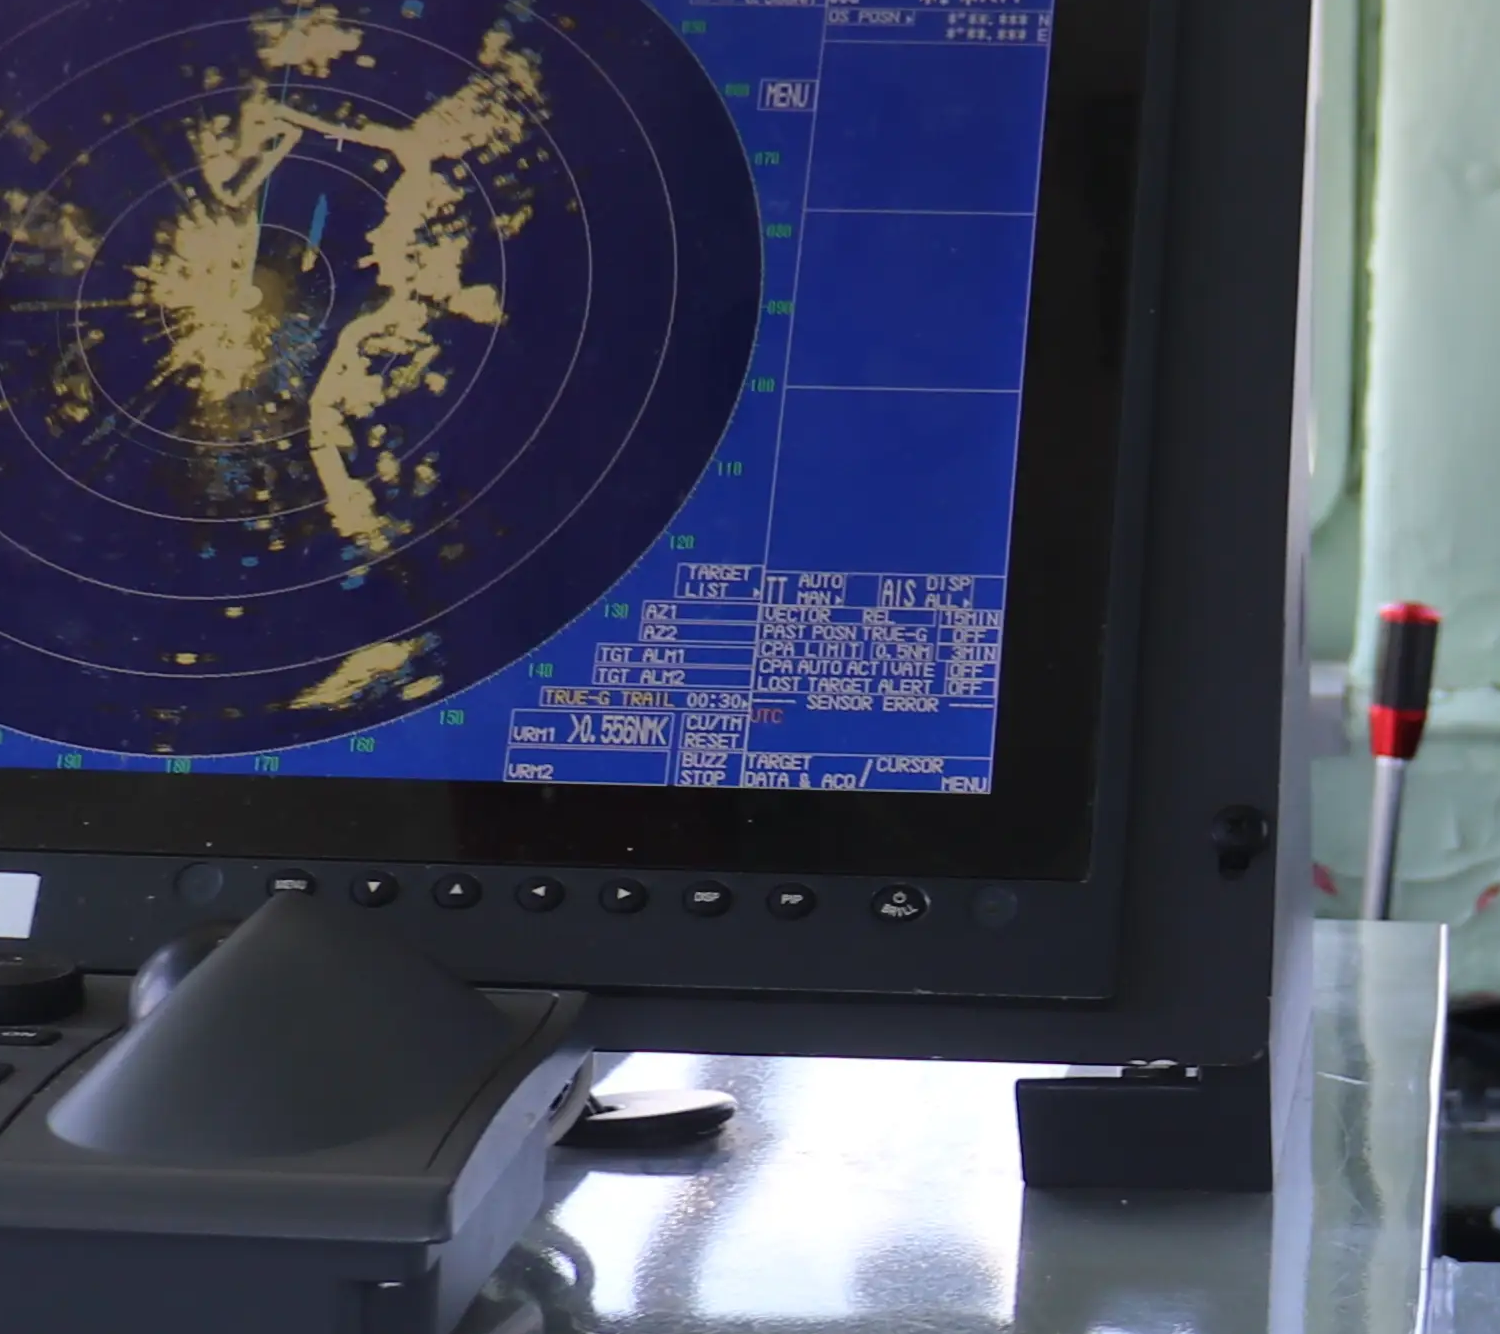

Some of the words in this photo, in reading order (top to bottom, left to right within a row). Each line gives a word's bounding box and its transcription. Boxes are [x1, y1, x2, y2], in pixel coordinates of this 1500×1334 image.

[858, 10, 900, 23] POSN
[765, 83, 811, 108] MENU
[690, 565, 751, 581] TARGET
[685, 582, 729, 597] LIST
[766, 576, 788, 604] TT
[798, 575, 844, 589] AUTO
[926, 576, 972, 592] DISP
[797, 592, 831, 605] MAN
[881, 580, 917, 607] AIS
[924, 594, 958, 608] ALL
[646, 605, 677, 619] AZ1
[765, 607, 831, 622] VECTOR
[863, 610, 895, 624] REL
[942, 610, 999, 626] 15MIN
[643, 625, 677, 640] AZ2
[762, 625, 805, 639] PAST
[812, 626, 856, 641] POSN
[863, 627, 928, 642] TRUE-G
[952, 630, 986, 643] OFF
[602, 648, 633, 663] TGT
[643, 649, 686, 664] ALM1
[760, 642, 795, 657] CPA
[804, 643, 860, 658] LIMIT
[875, 644, 930, 660] 0.5NM
[951, 646, 996, 661] 3MIN
[758, 659, 793, 674] CPA
[797, 660, 842, 674] AUTO
[846, 661, 936, 678] ACTIVATE
[949, 663, 985, 678] OFF
[599, 668, 630, 683] TGT
[640, 670, 686, 686] ALM2
[757, 676, 802, 691] LOST
[808, 677, 871, 693] TARGET
[878, 679, 933, 695] ALERT
[948, 681, 982, 695] OFF
[545, 689, 611, 706] TRUE-G
[621, 691, 675, 708] TRAIL
[686, 692, 741, 709] 00:30
[806, 695, 873, 711] SENSOR
[883, 696, 940, 713] ERROR
[686, 715, 742, 731] CU/TM
[750, 709, 784, 724] UTC
[513, 726, 556, 742] VRM1
[684, 733, 739, 749] RESET
[681, 752, 728, 768] BUZZ
[748, 755, 813, 770] TARGET
[876, 757, 944, 774] CURSOR
[508, 763, 554, 780] VRM2
[680, 771, 726, 787] STOP
[745, 772, 789, 787] DATA
[821, 774, 856, 789] ACQ
[941, 777, 988, 792] MENU
[781, 894, 803, 905] PIP
